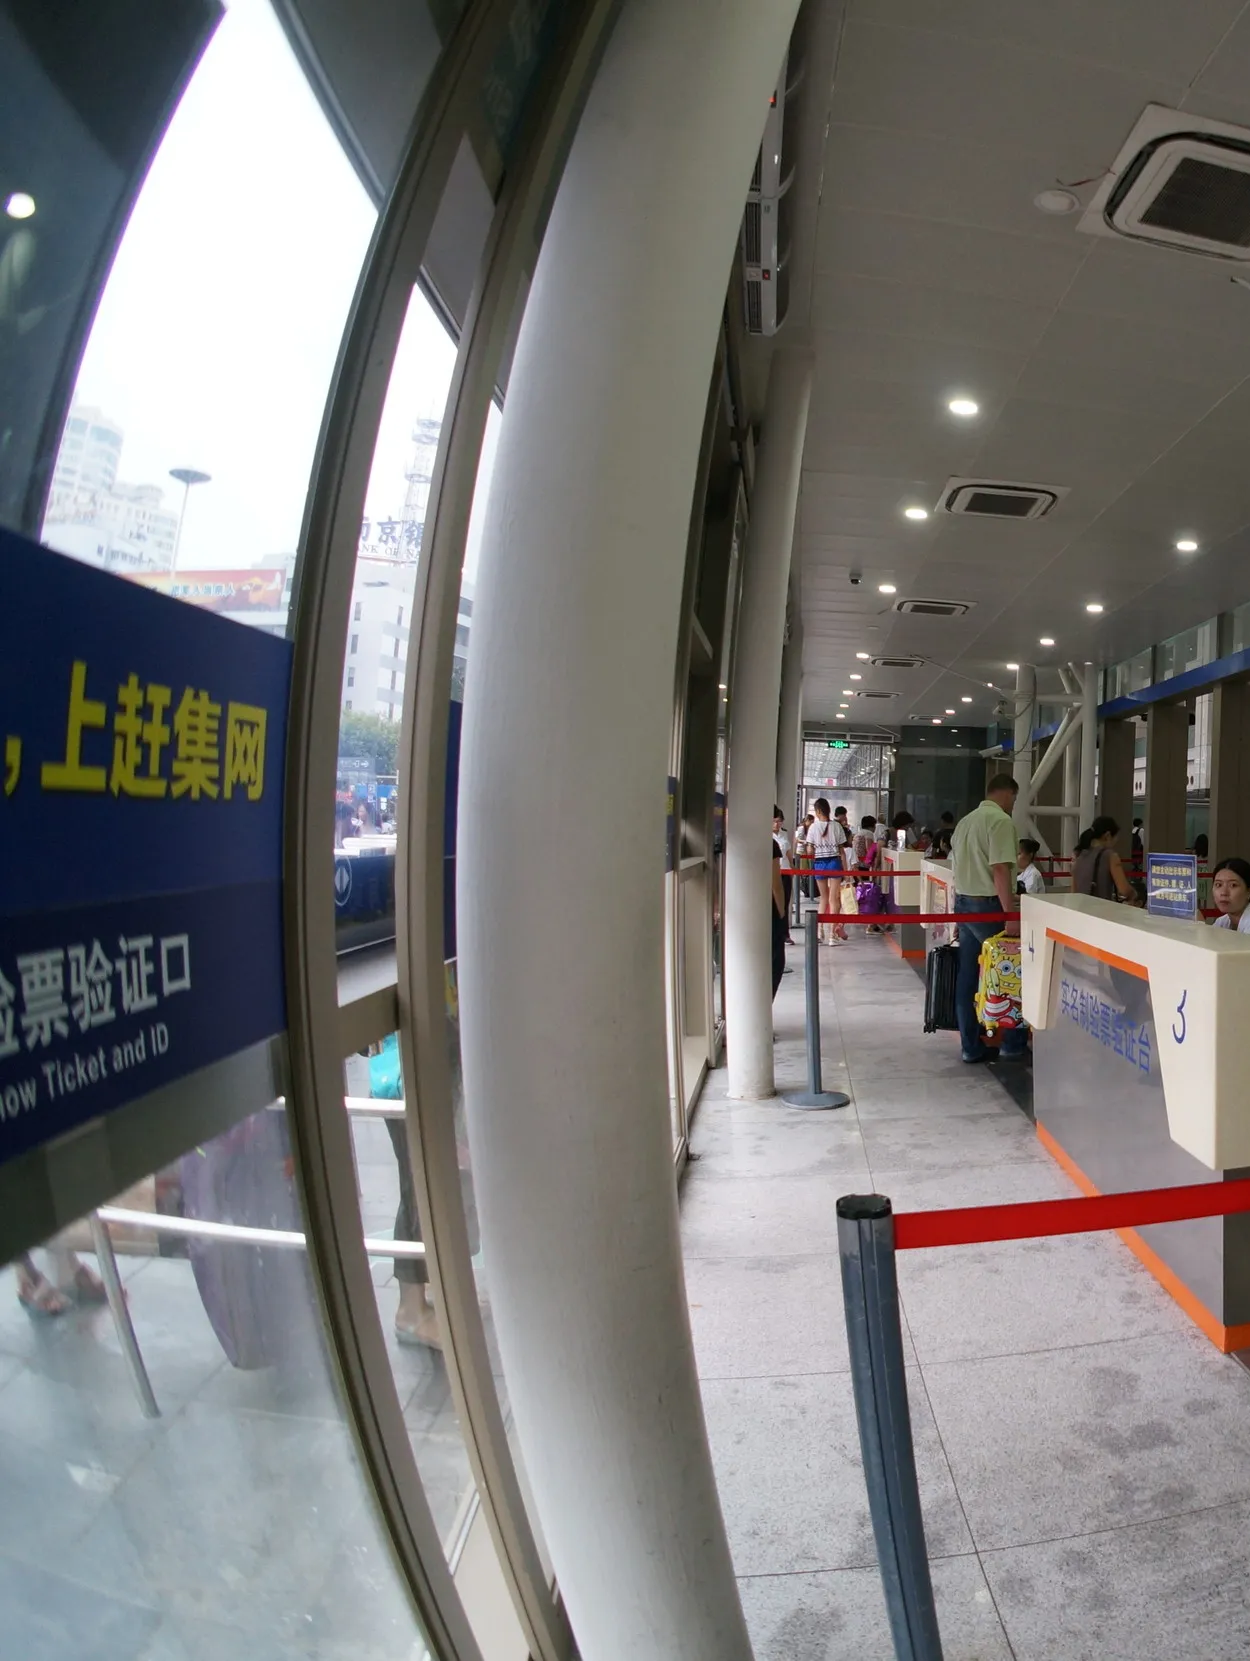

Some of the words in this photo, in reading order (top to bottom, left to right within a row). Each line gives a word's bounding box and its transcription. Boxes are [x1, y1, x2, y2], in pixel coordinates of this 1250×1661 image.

[1172, 989, 1187, 1044] 3
[41, 1050, 108, 1101] Ticket
[113, 1029, 147, 1073] and
[150, 1022, 170, 1057] ID
